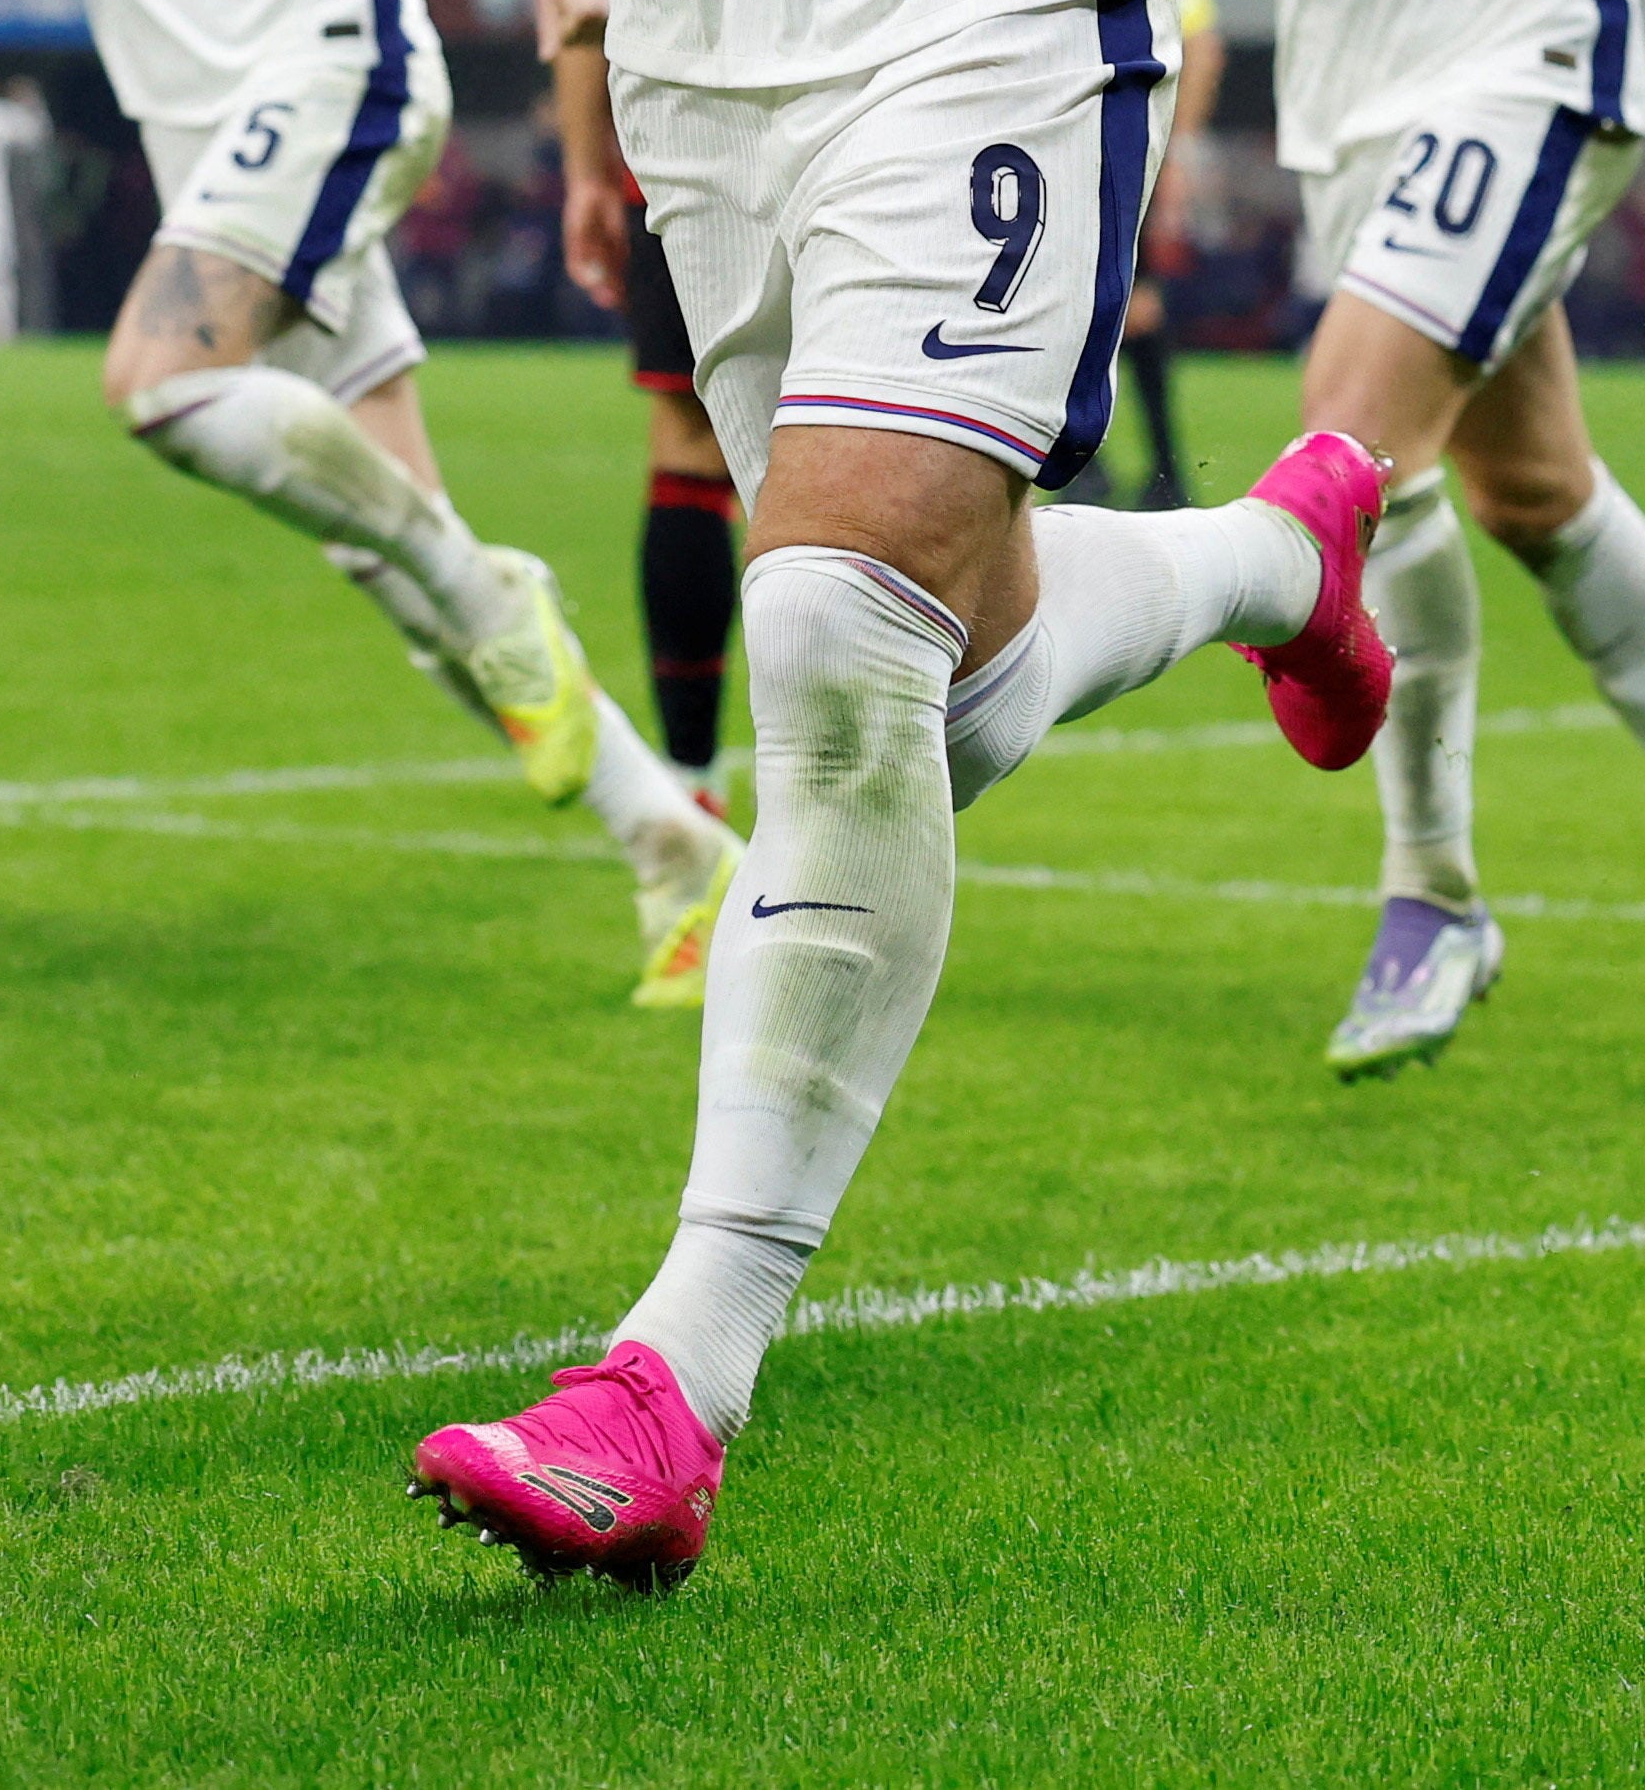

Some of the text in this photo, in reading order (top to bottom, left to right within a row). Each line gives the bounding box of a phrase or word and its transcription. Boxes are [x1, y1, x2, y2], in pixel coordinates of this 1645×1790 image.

[231, 101, 296, 172] 5
[1384, 131, 1499, 239] 20
[971, 143, 1046, 314] 9
